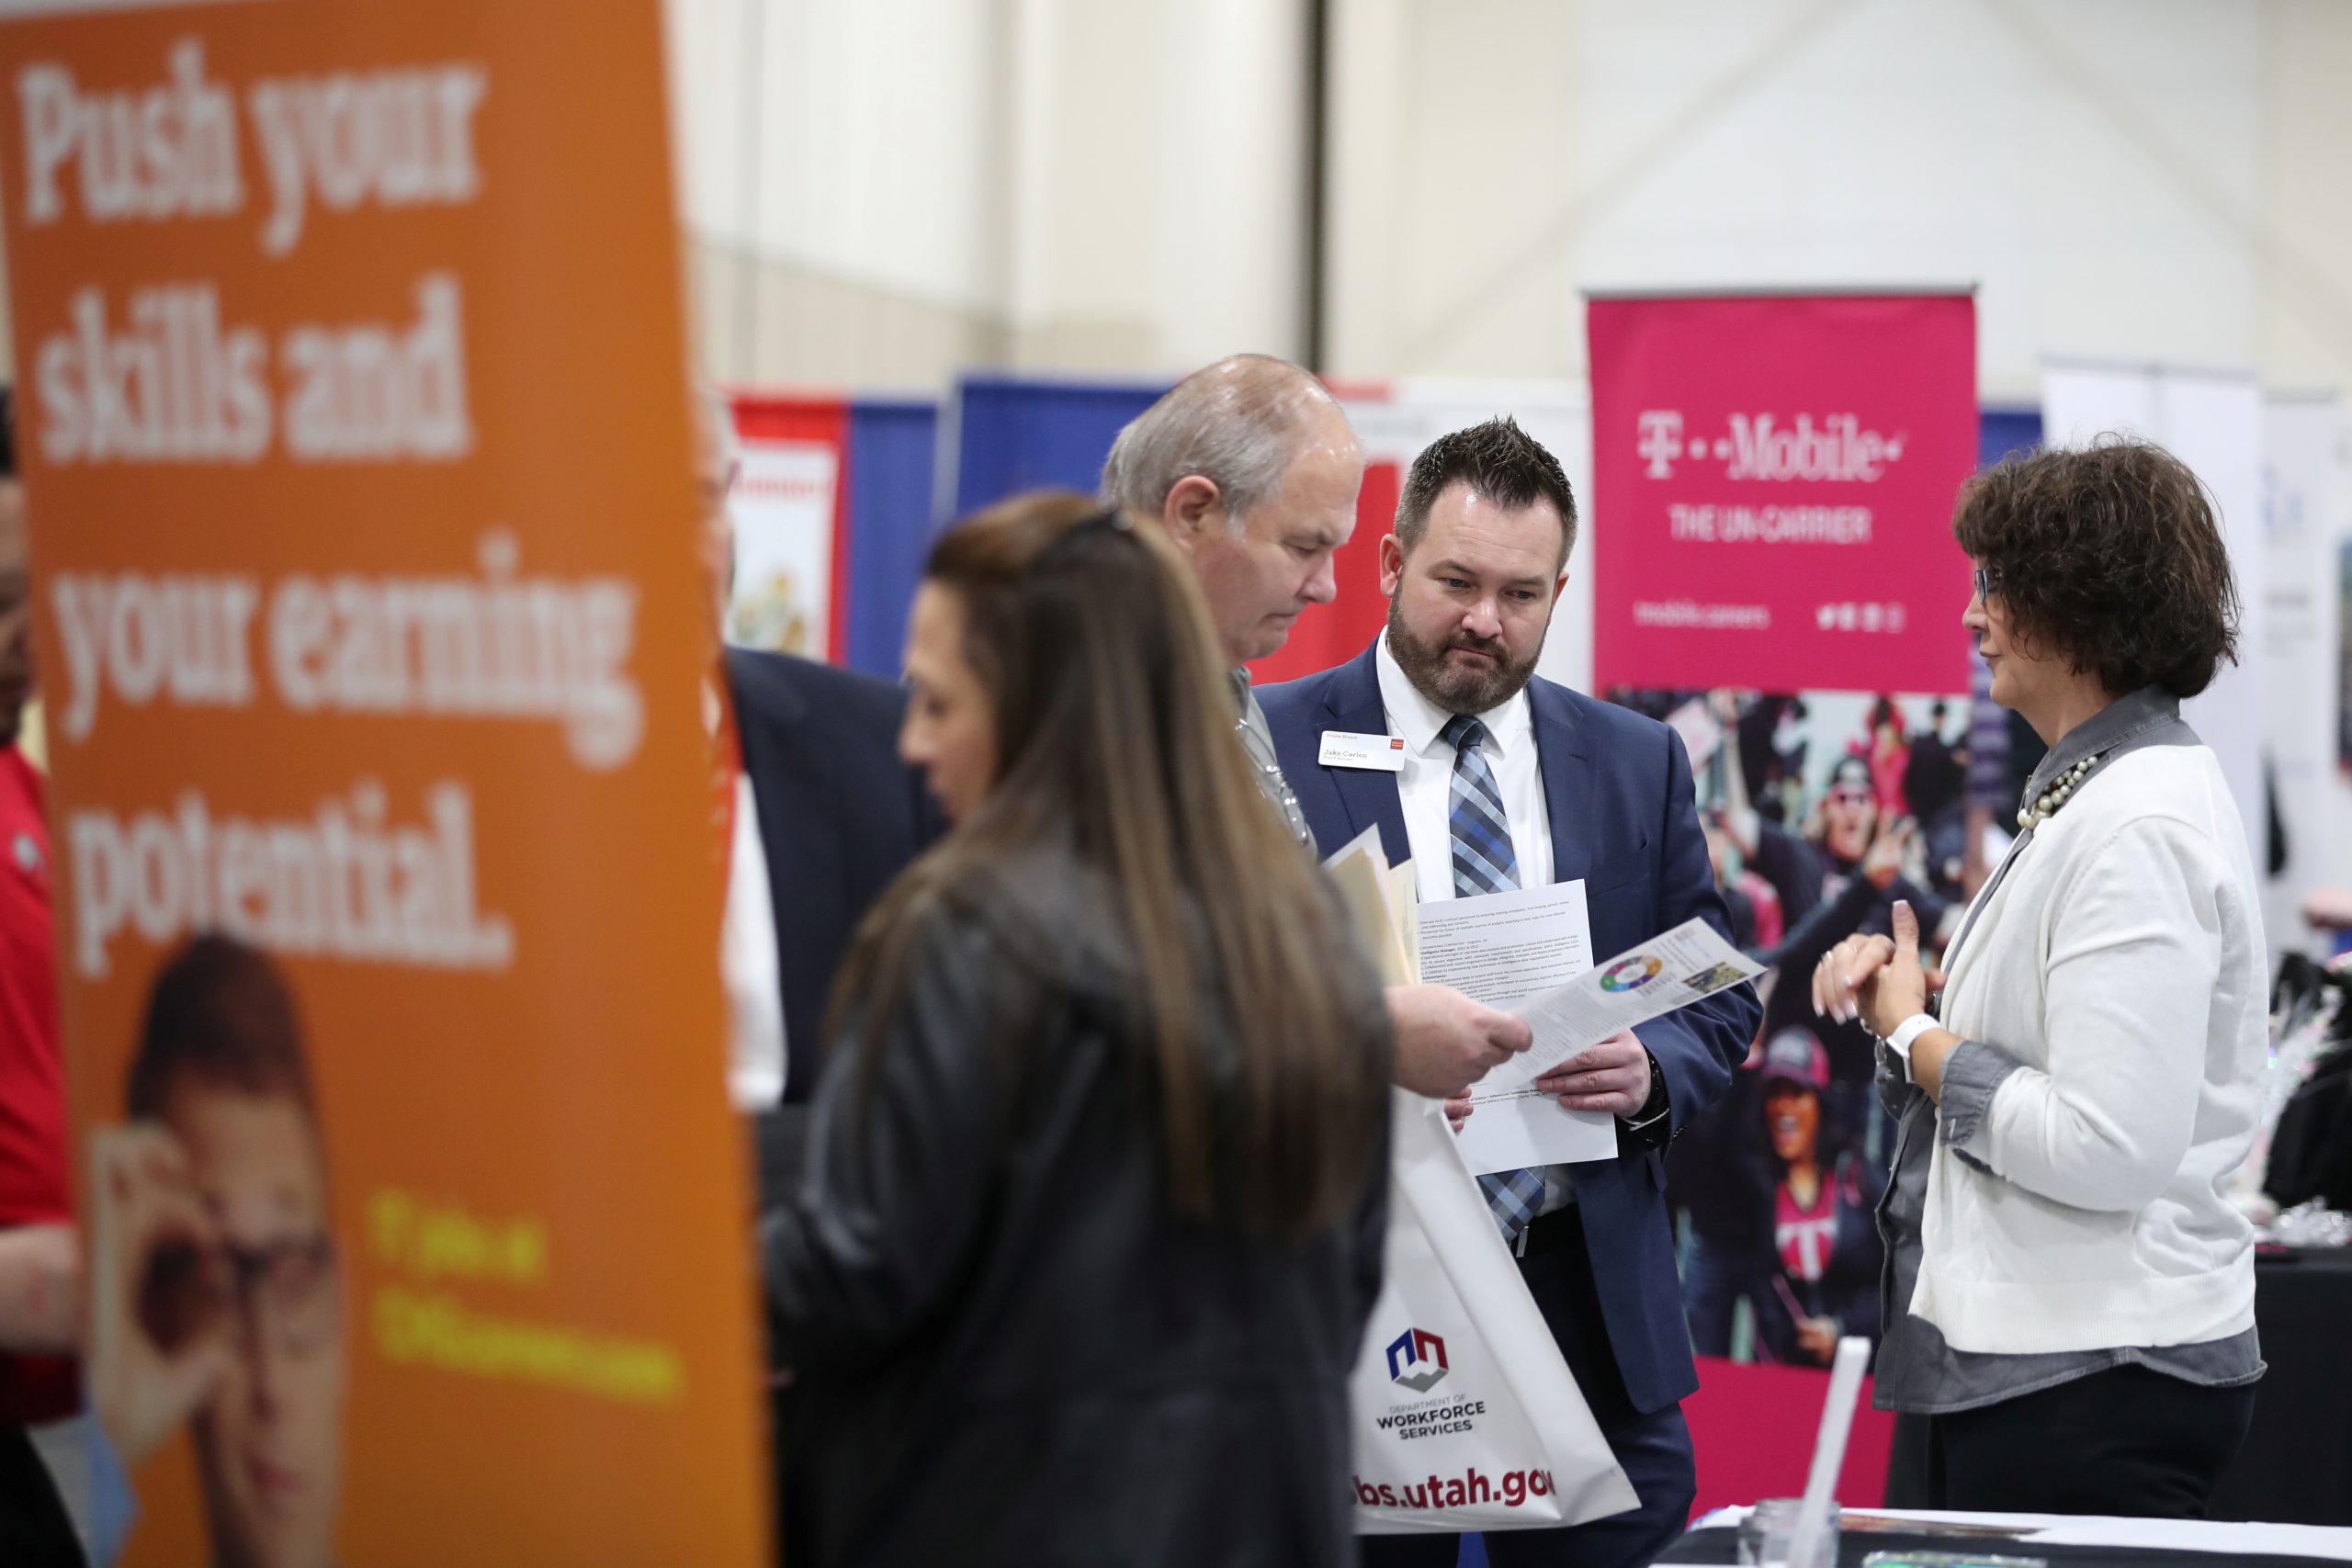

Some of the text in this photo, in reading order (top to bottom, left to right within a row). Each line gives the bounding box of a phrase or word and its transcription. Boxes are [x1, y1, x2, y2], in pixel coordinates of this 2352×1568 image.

[17, 38, 487, 256] Push your
[35, 268, 476, 465] skills and
[1668, 503, 1871, 544] THE UN-CARRIER
[51, 525, 645, 770] your earning
[1324, 749, 1341, 757] Jake
[68, 778, 516, 981] potential.
[1376, 1401, 1486, 1429] WORKFORCE
[1389, 1393, 1466, 1415] DEPARTMENT OF
[1399, 1419, 1473, 1440] SERVICES
[1351, 1467, 1555, 1509] bs.utah.gov
